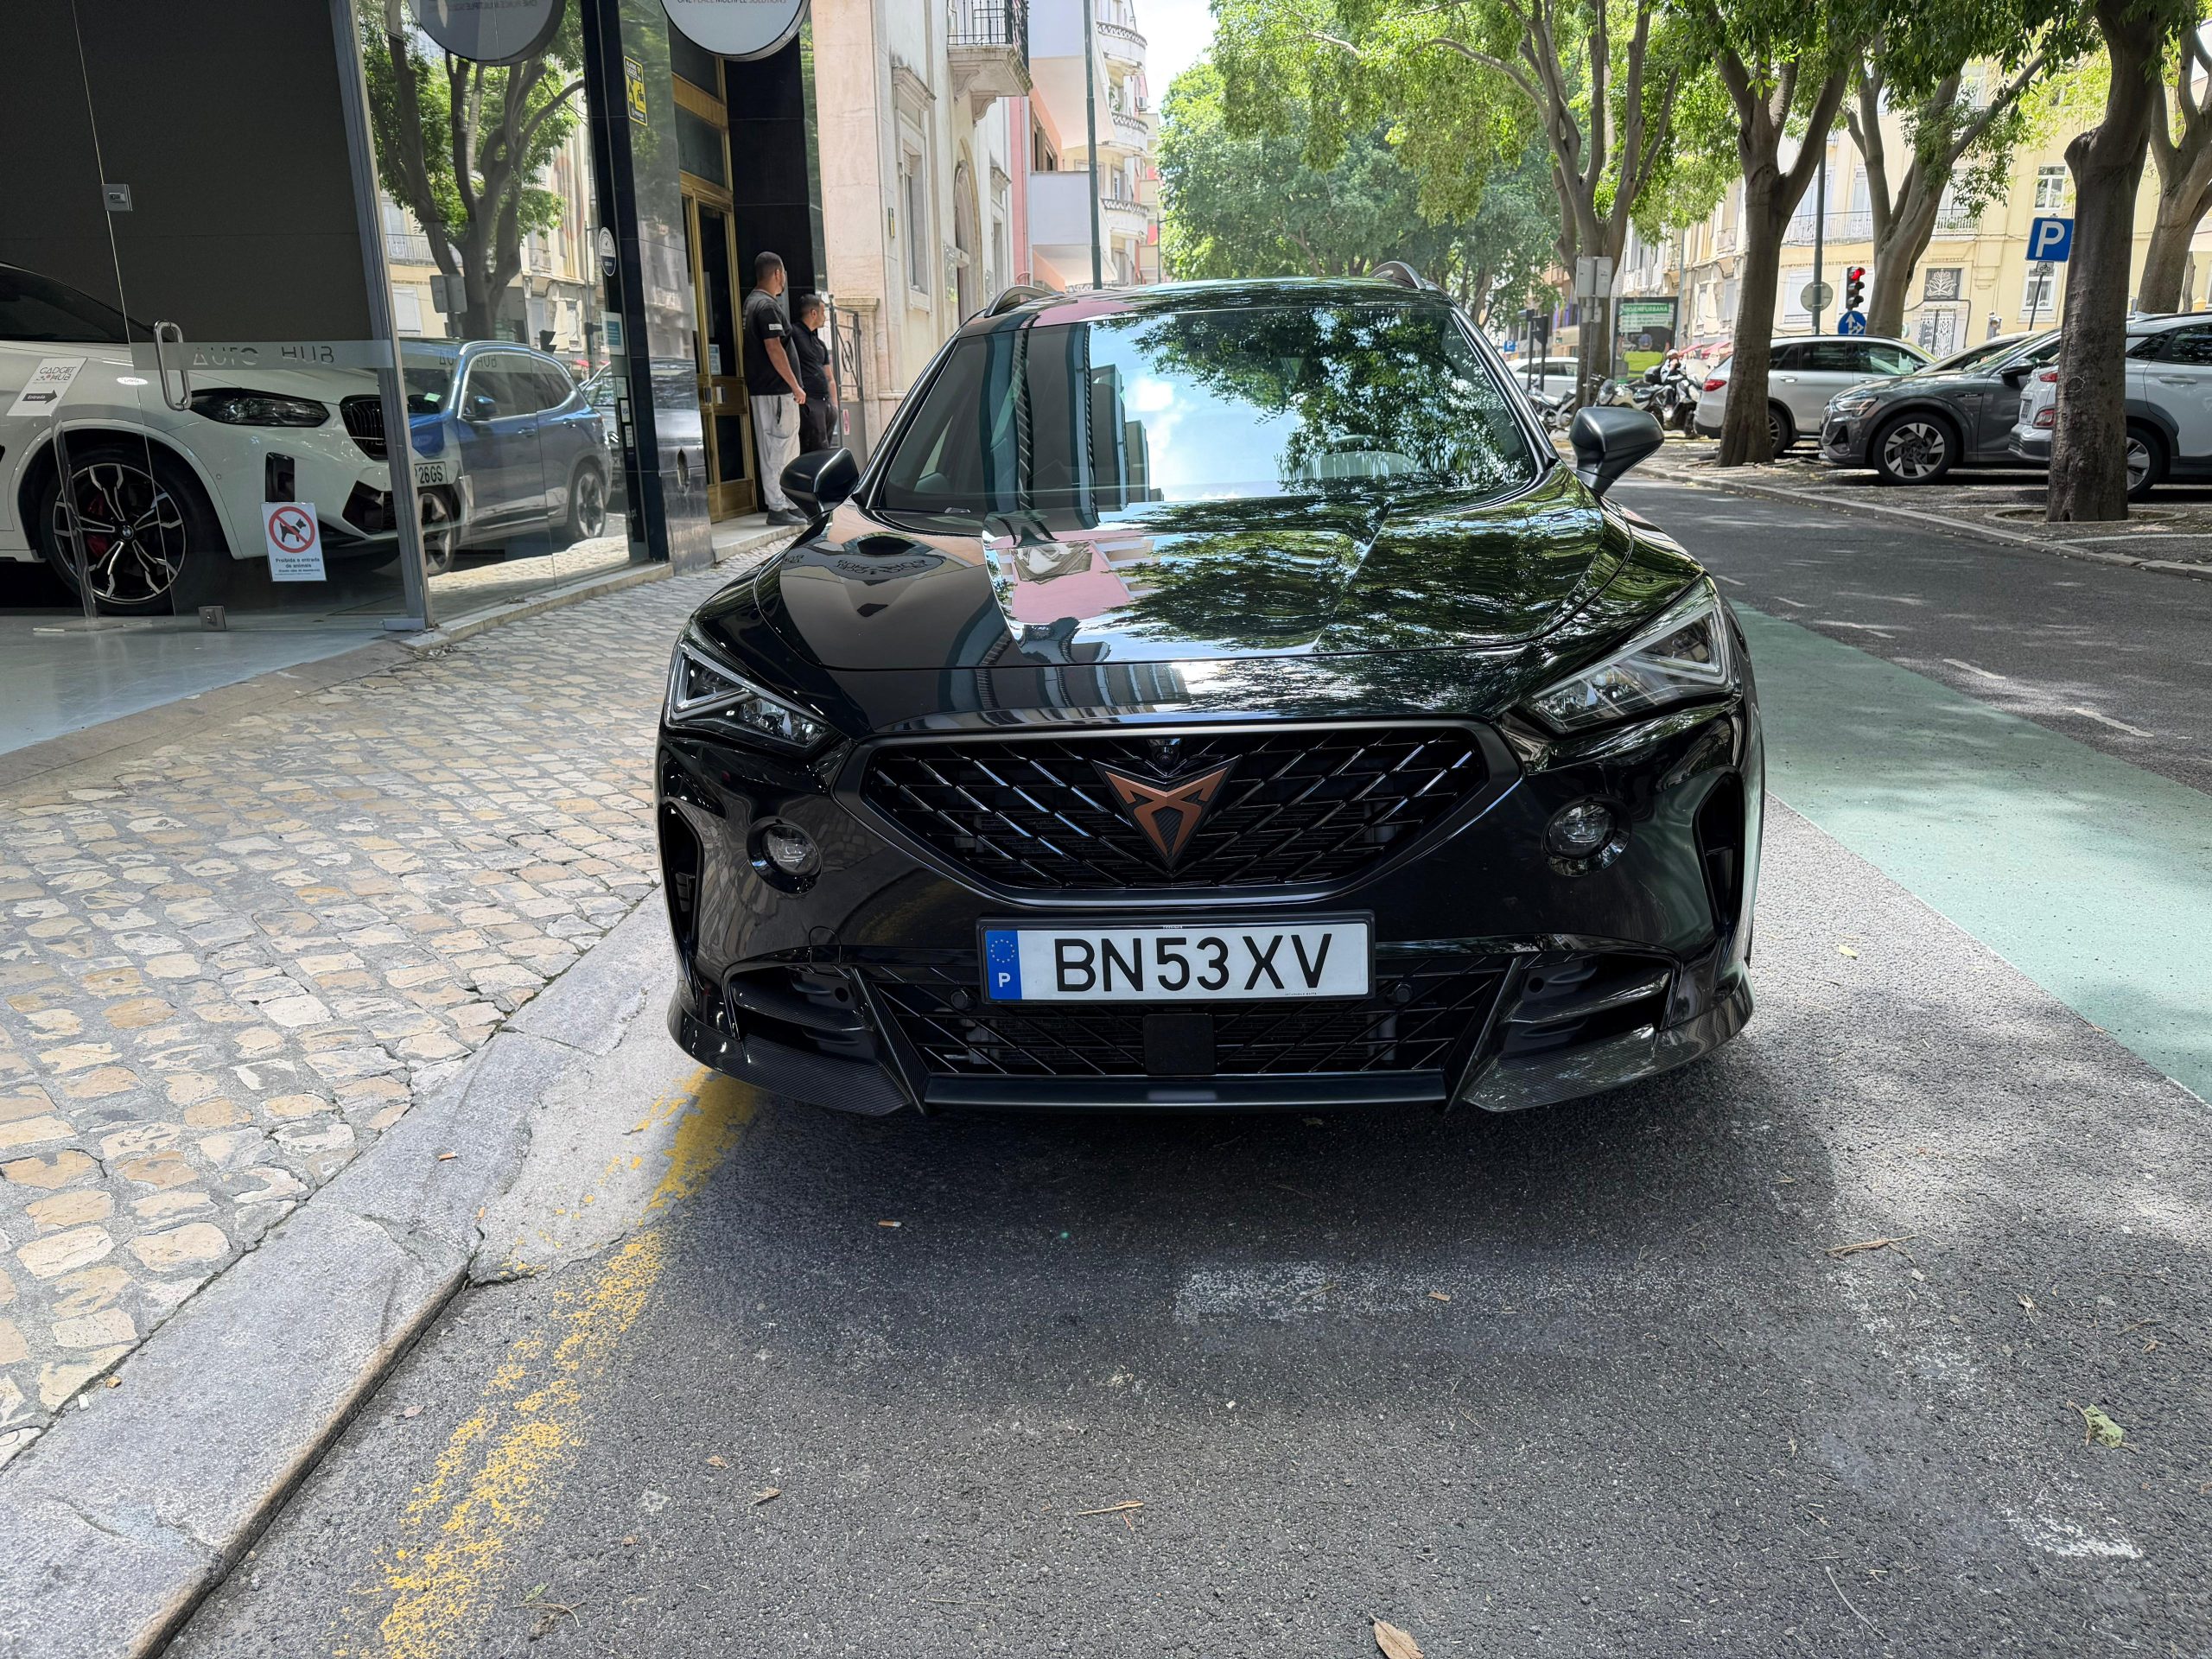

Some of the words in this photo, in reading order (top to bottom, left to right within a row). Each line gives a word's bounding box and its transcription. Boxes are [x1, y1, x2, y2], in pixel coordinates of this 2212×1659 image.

[2035, 220, 2065, 257] P
[1506, 340, 1513, 350] P
[193, 346, 258, 365] AUTO
[282, 346, 334, 365] HUB
[415, 465, 442, 484] 26GS
[998, 972, 1011, 987] P
